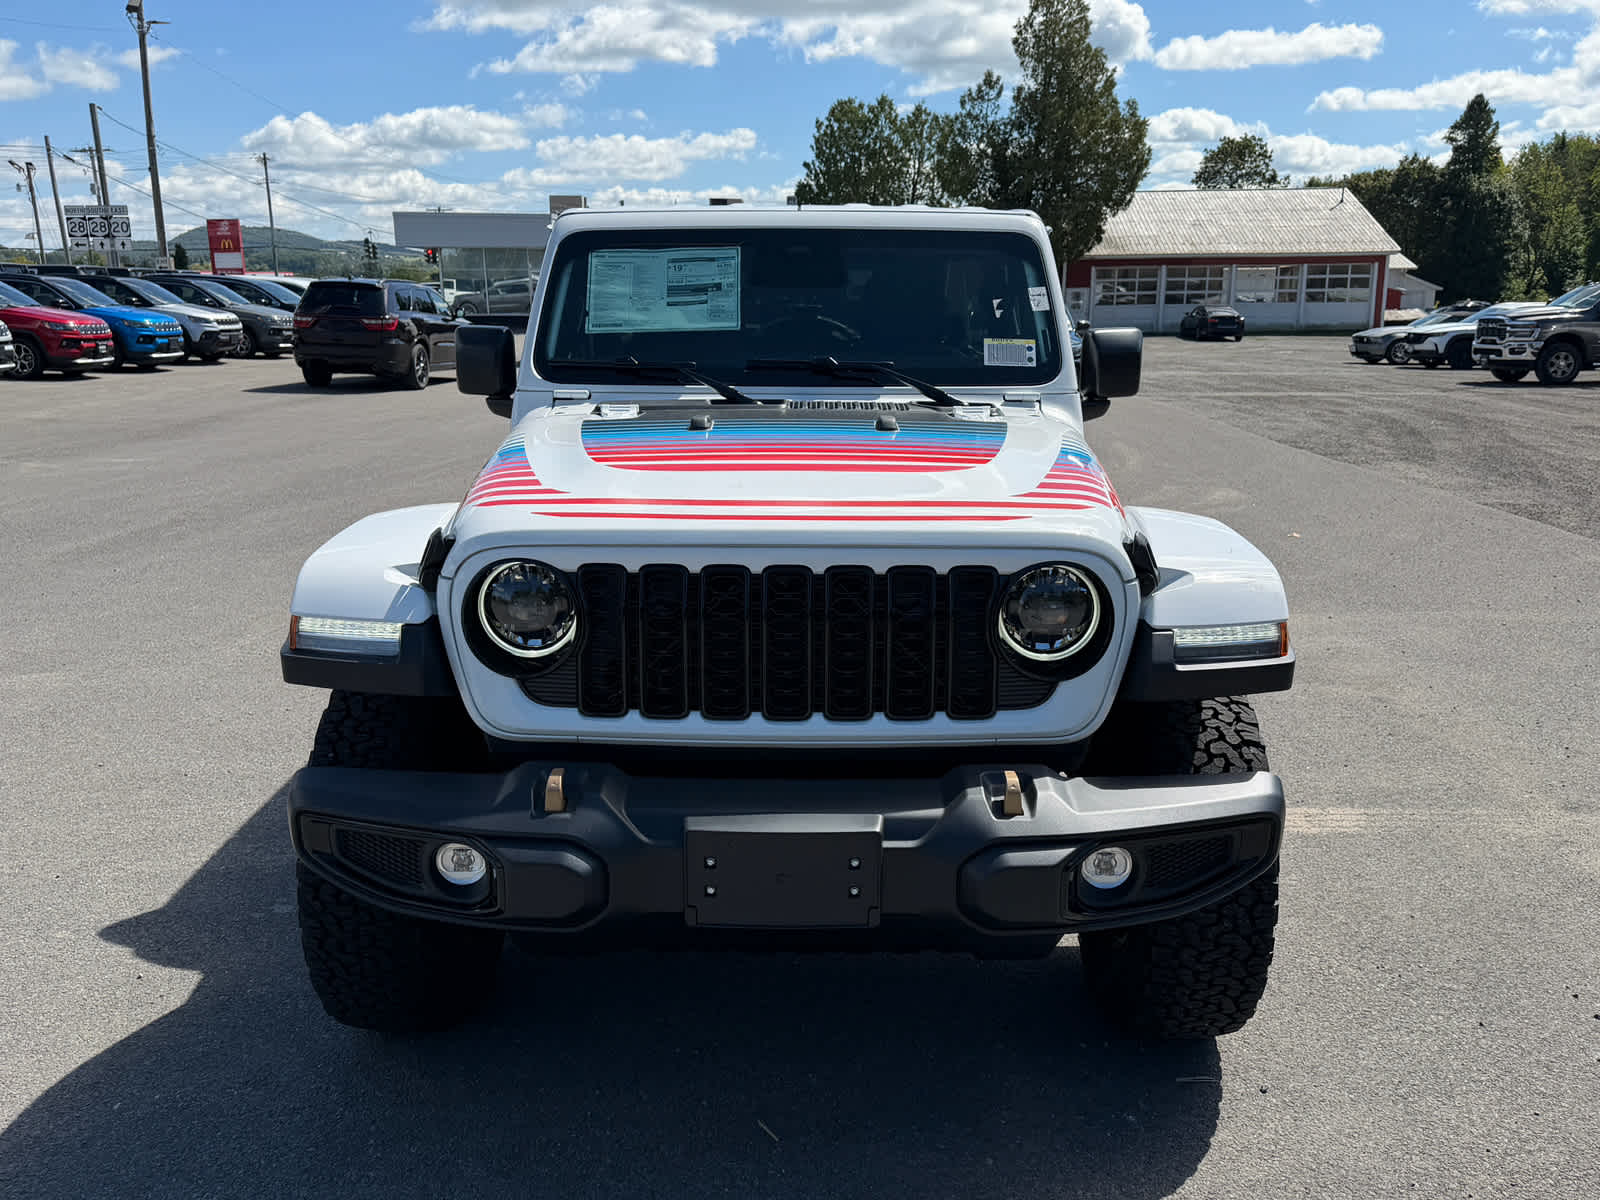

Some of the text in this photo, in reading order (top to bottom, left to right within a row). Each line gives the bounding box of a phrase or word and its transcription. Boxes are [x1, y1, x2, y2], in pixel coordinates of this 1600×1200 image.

[69, 221, 85, 233] 28
[90, 221, 107, 233] 28
[112, 221, 129, 233] 20
